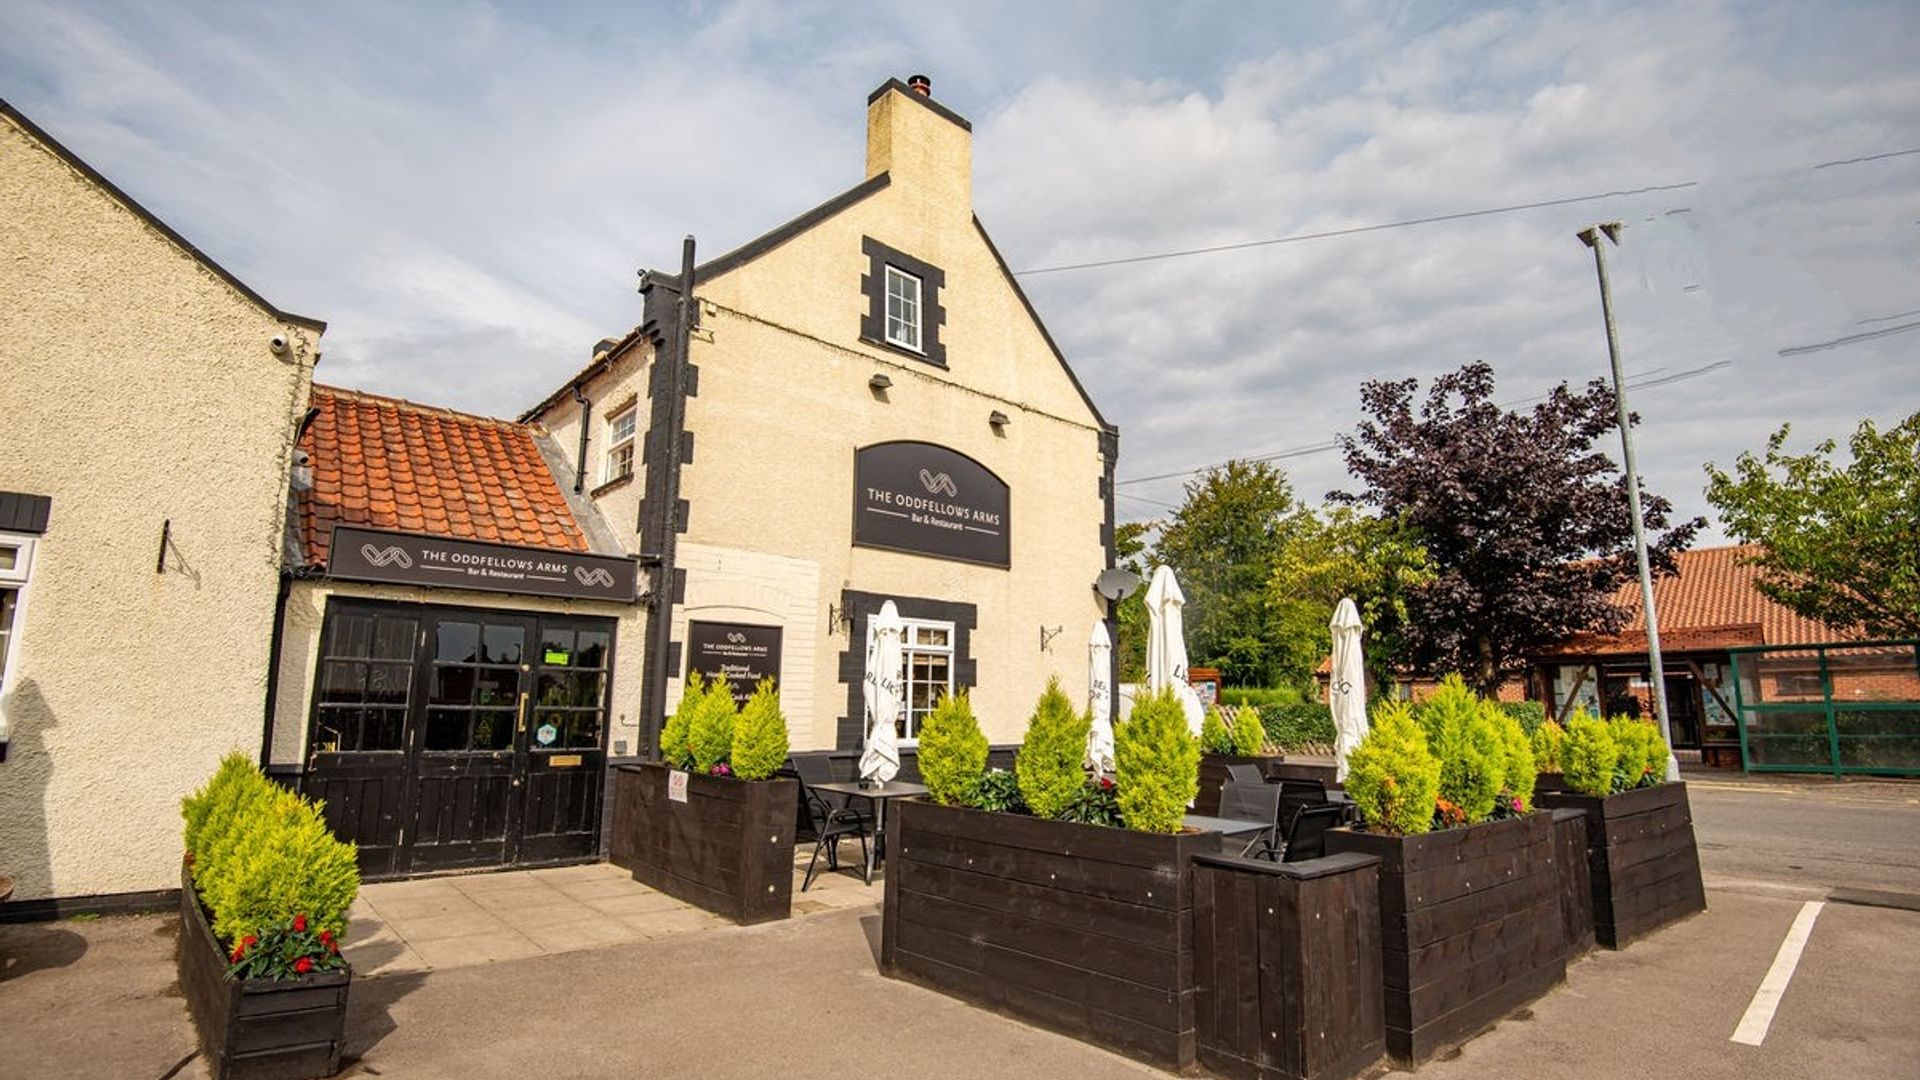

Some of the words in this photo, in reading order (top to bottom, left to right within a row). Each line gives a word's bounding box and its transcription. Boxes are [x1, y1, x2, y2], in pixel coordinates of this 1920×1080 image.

[867, 488, 892, 504] THE
[895, 494, 970, 520] ODDFELLOWS
[972, 510, 1000, 526] ARMS
[911, 513, 923, 523] Bar
[931, 516, 964, 531] Restaurant
[422, 550, 447, 562] THE
[451, 553, 534, 572] ODDFELLOWS
[536, 562, 568, 575] ARMS
[467, 567, 480, 576] Bar
[481, 568, 488, 576] &
[489, 569, 525, 580] Restaurant
